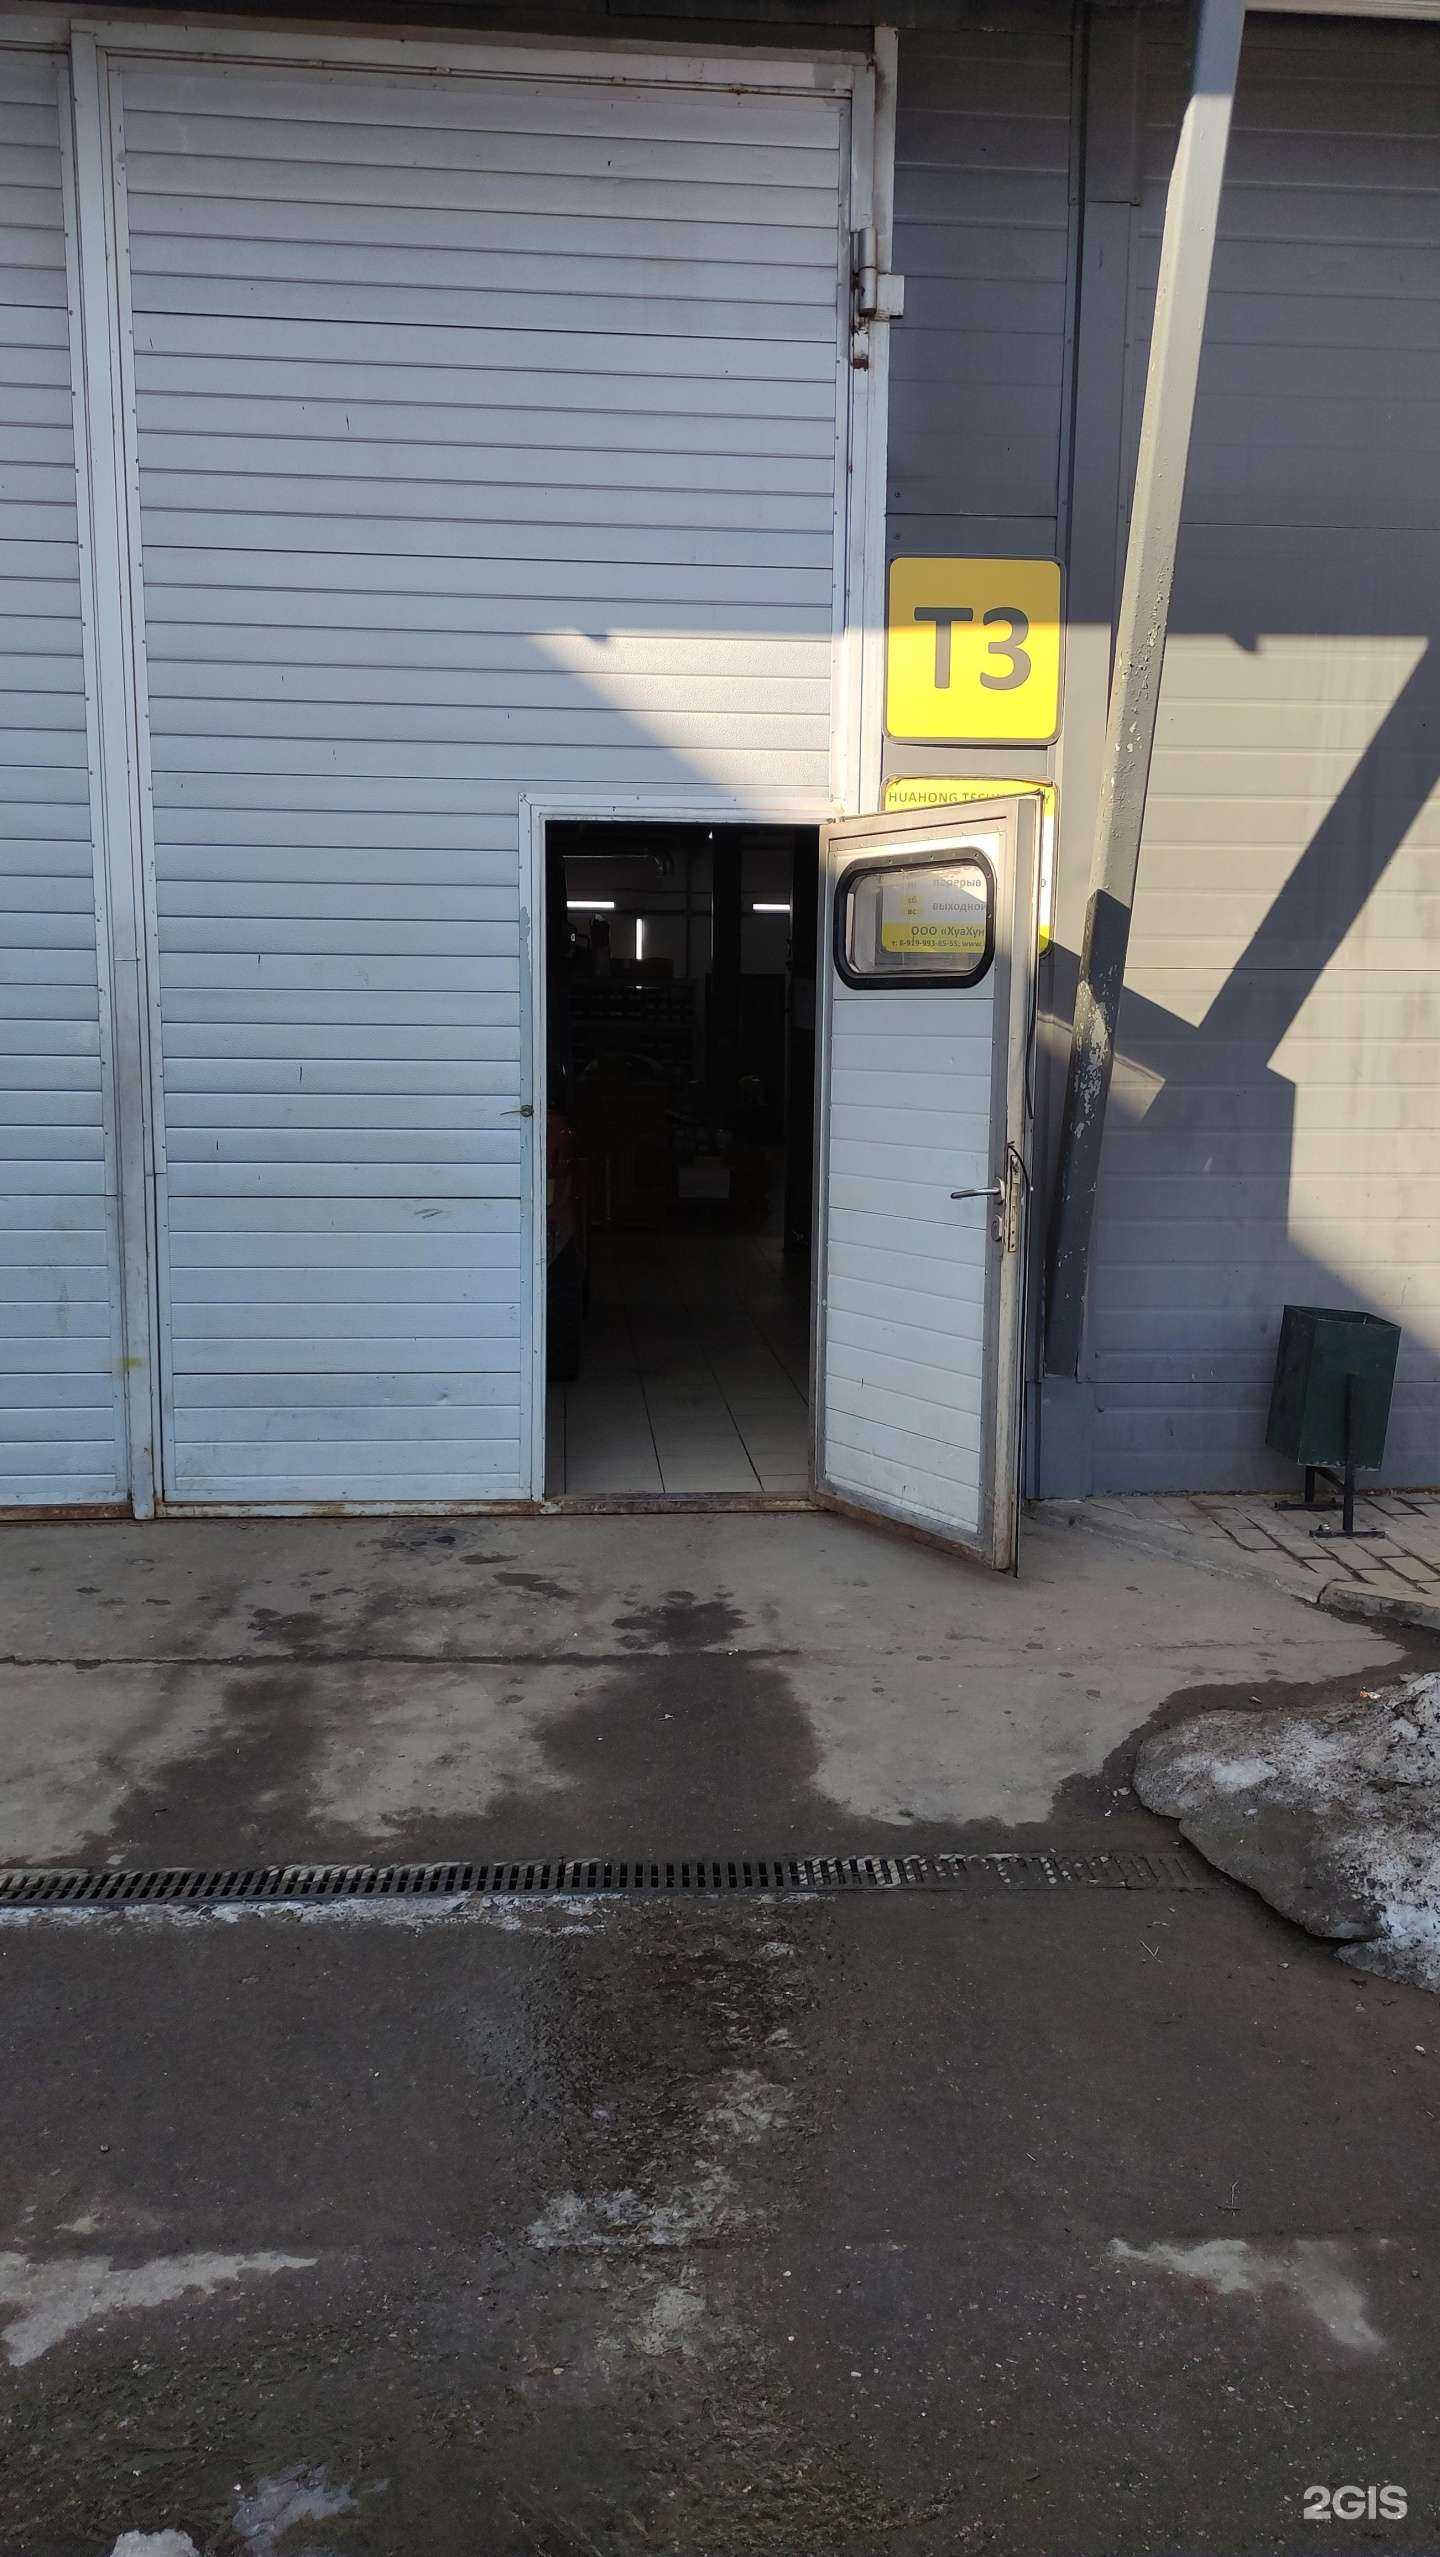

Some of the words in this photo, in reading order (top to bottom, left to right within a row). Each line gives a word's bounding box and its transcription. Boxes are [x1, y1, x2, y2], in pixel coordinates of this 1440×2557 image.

[914, 607, 1031, 690] T3
[889, 791, 957, 804] HUAHONG
[911, 926, 937, 936] ООО
